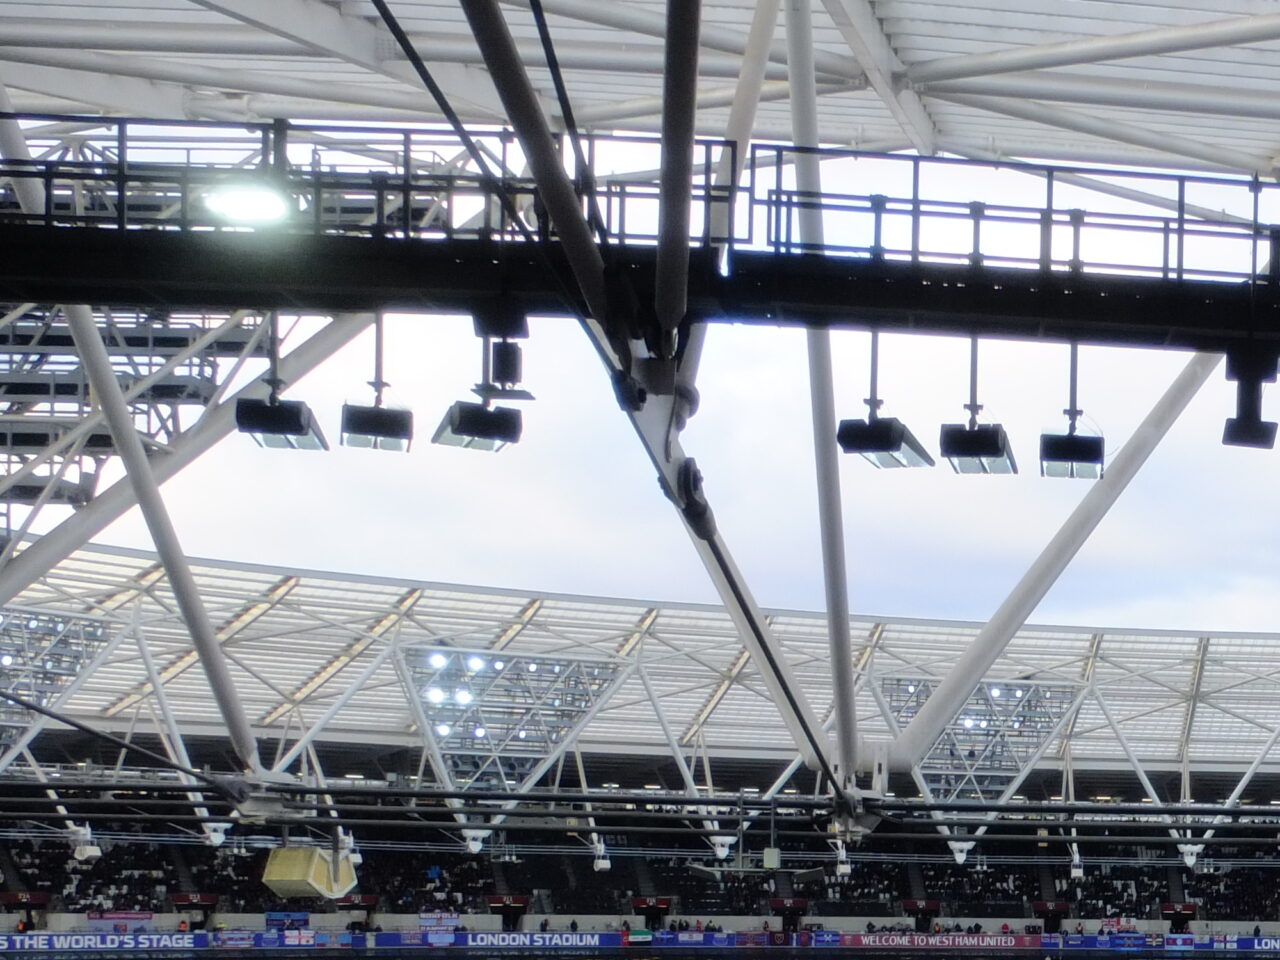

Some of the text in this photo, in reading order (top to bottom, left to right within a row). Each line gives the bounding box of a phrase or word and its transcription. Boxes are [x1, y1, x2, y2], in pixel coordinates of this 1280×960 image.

[12, 935, 49, 948] THE
[52, 935, 136, 948] WORLD'S
[137, 935, 195, 948] STAGE
[467, 934, 599, 946] LONDON STADIUM
[861, 935, 1015, 947] WELCOME TO WEST HAM UNITED
